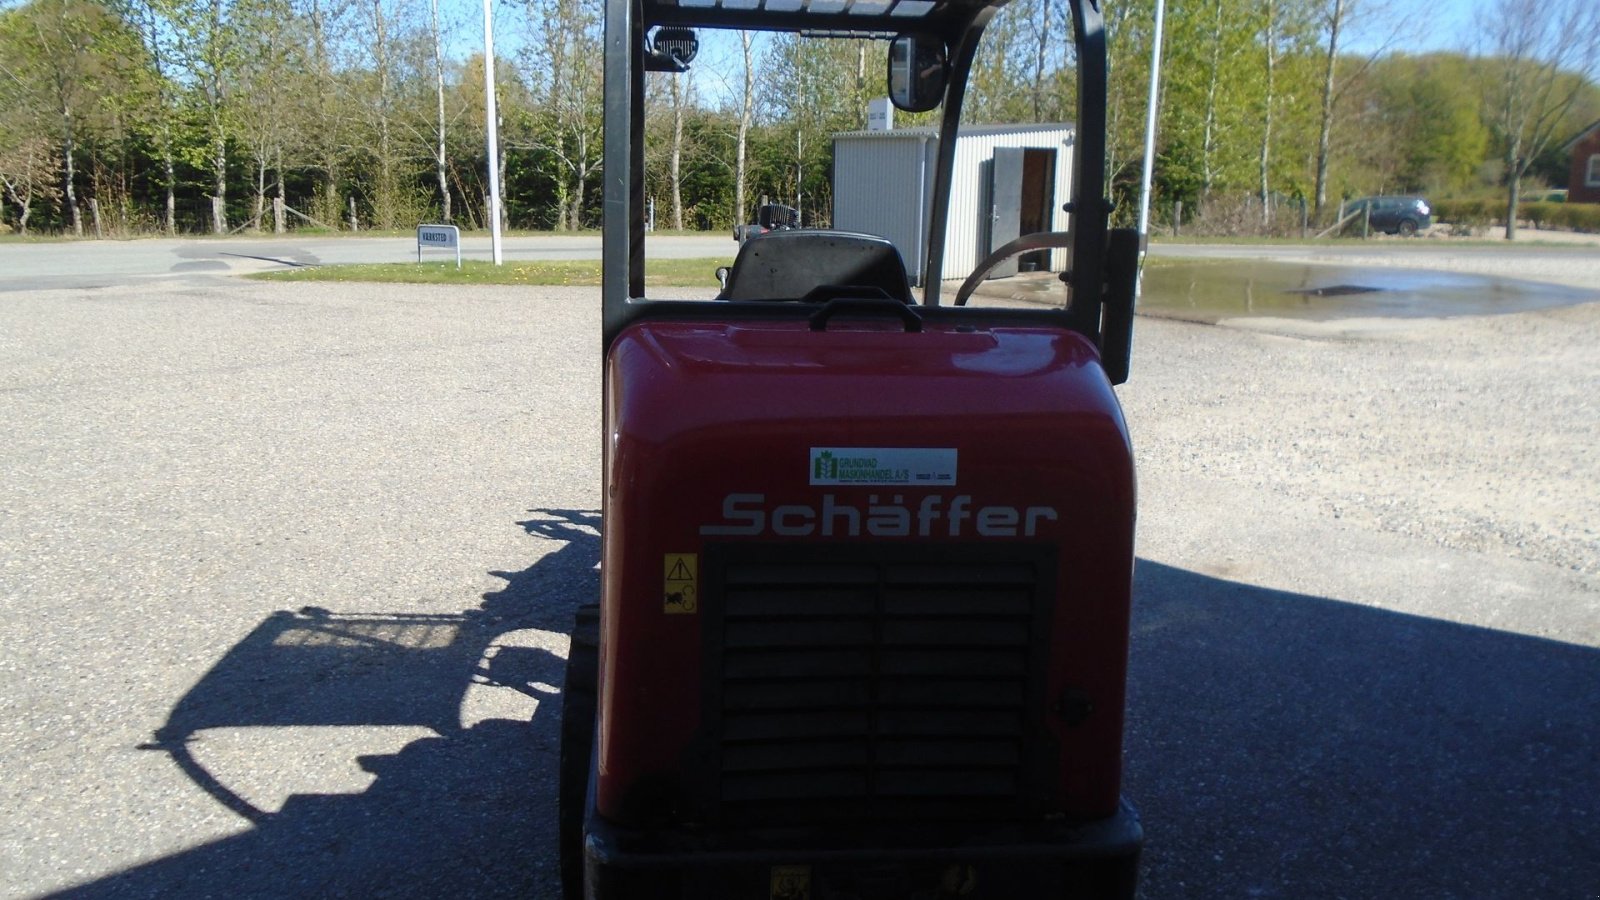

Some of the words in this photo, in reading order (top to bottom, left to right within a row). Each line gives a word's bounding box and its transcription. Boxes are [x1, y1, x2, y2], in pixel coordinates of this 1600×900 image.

[839, 457, 878, 469] GRUNDVAD
[839, 469, 893, 480] MASKINHANDEL
[699, 493, 1059, 537] Schäffer
